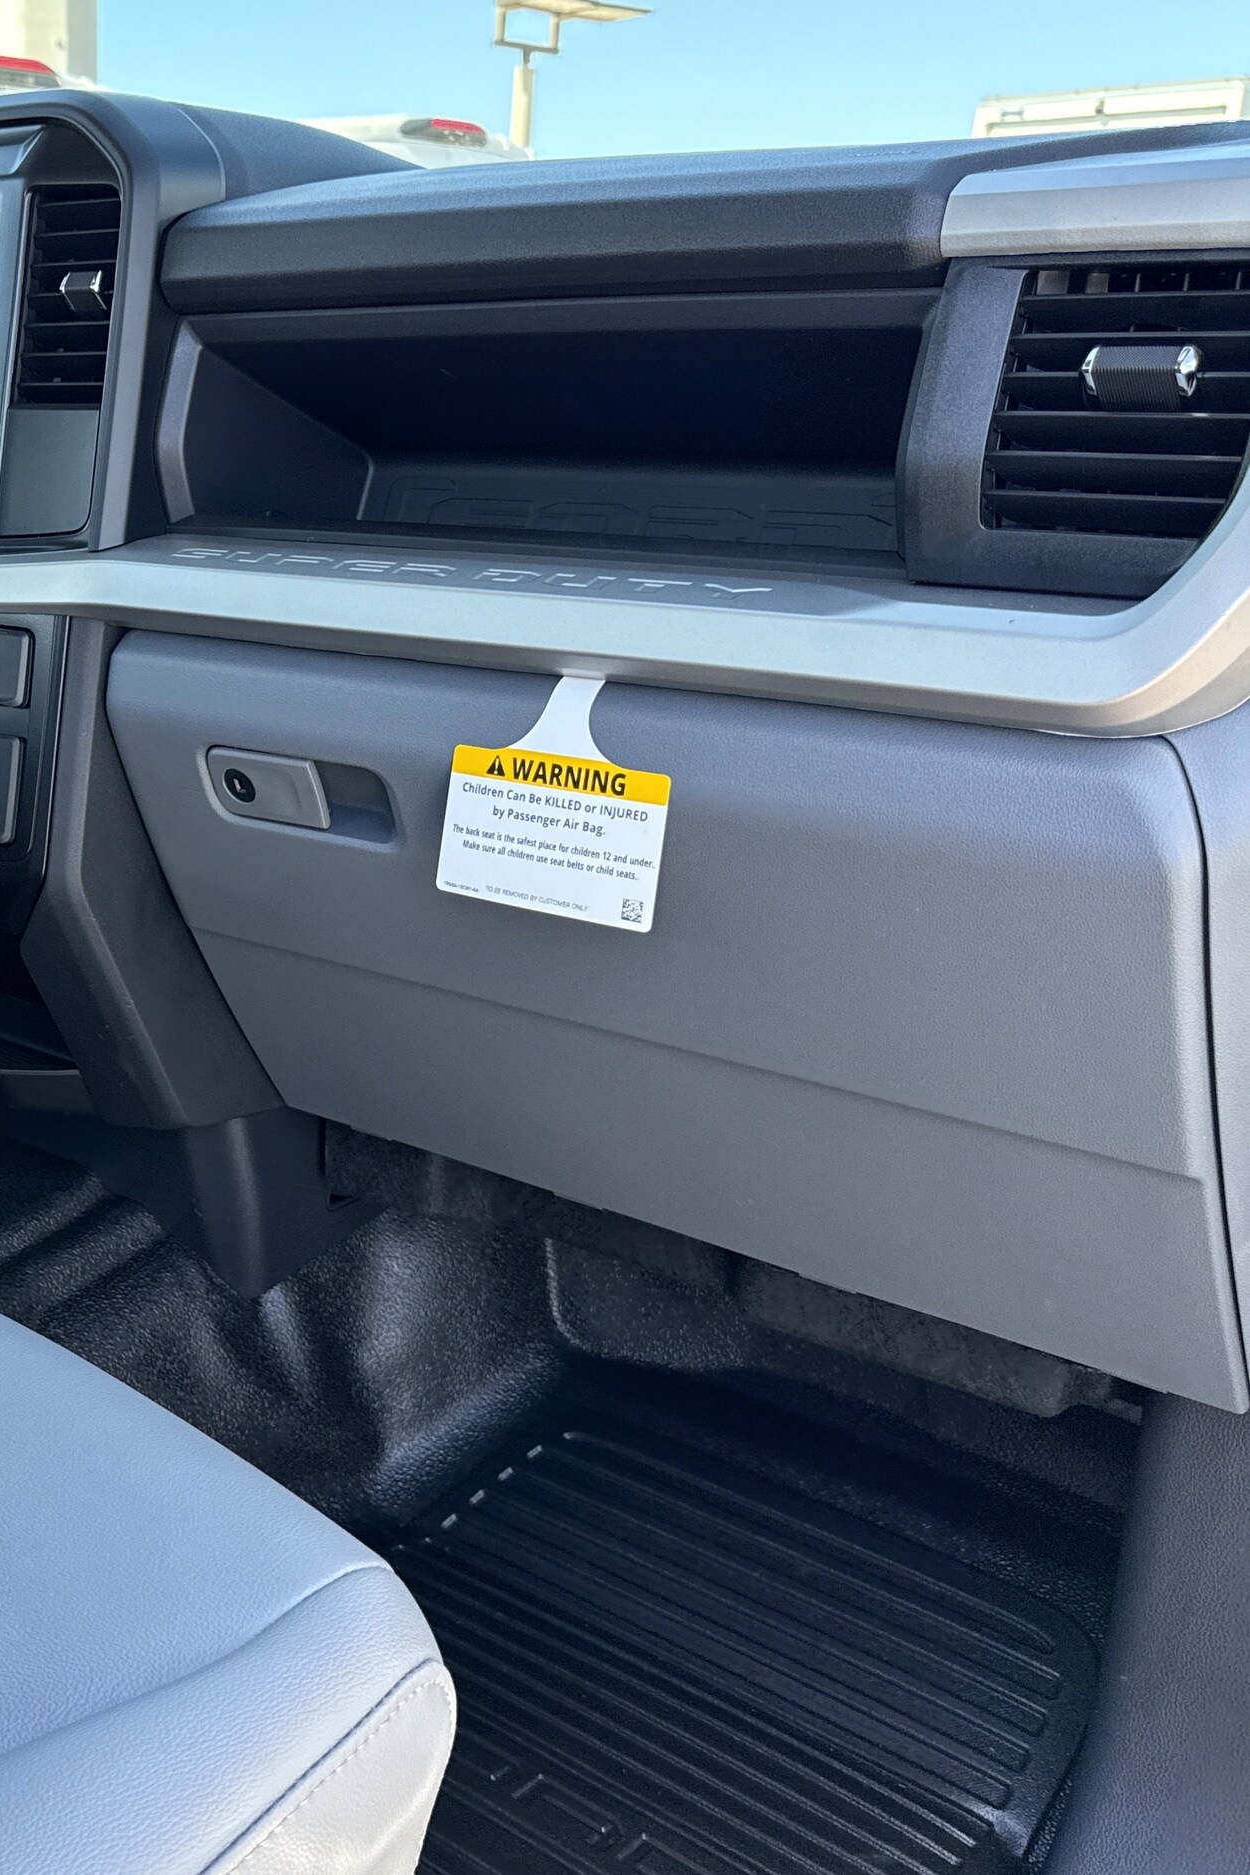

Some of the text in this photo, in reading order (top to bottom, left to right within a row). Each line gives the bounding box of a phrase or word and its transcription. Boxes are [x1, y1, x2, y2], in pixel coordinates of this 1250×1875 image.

[171, 548, 773, 599] SUPER DUTY
[512, 757, 627, 796] WARNING
[462, 782, 648, 822] Children Can Be KILLED or INJURED
[492, 805, 605, 837] by Passenger Air Bag.
[453, 823, 655, 869] The back seat is the safest place for children 12 and under.
[463, 839, 638, 881] Make sure all children use seat belts or child seats.
[485, 885, 493, 893] TO
[494, 887, 502, 895] BE
[502, 888, 529, 900] REMOVED
[530, 894, 538, 902] BY
[538, 895, 571, 908] CUSTOMER
[572, 903, 588, 912] ONLY
